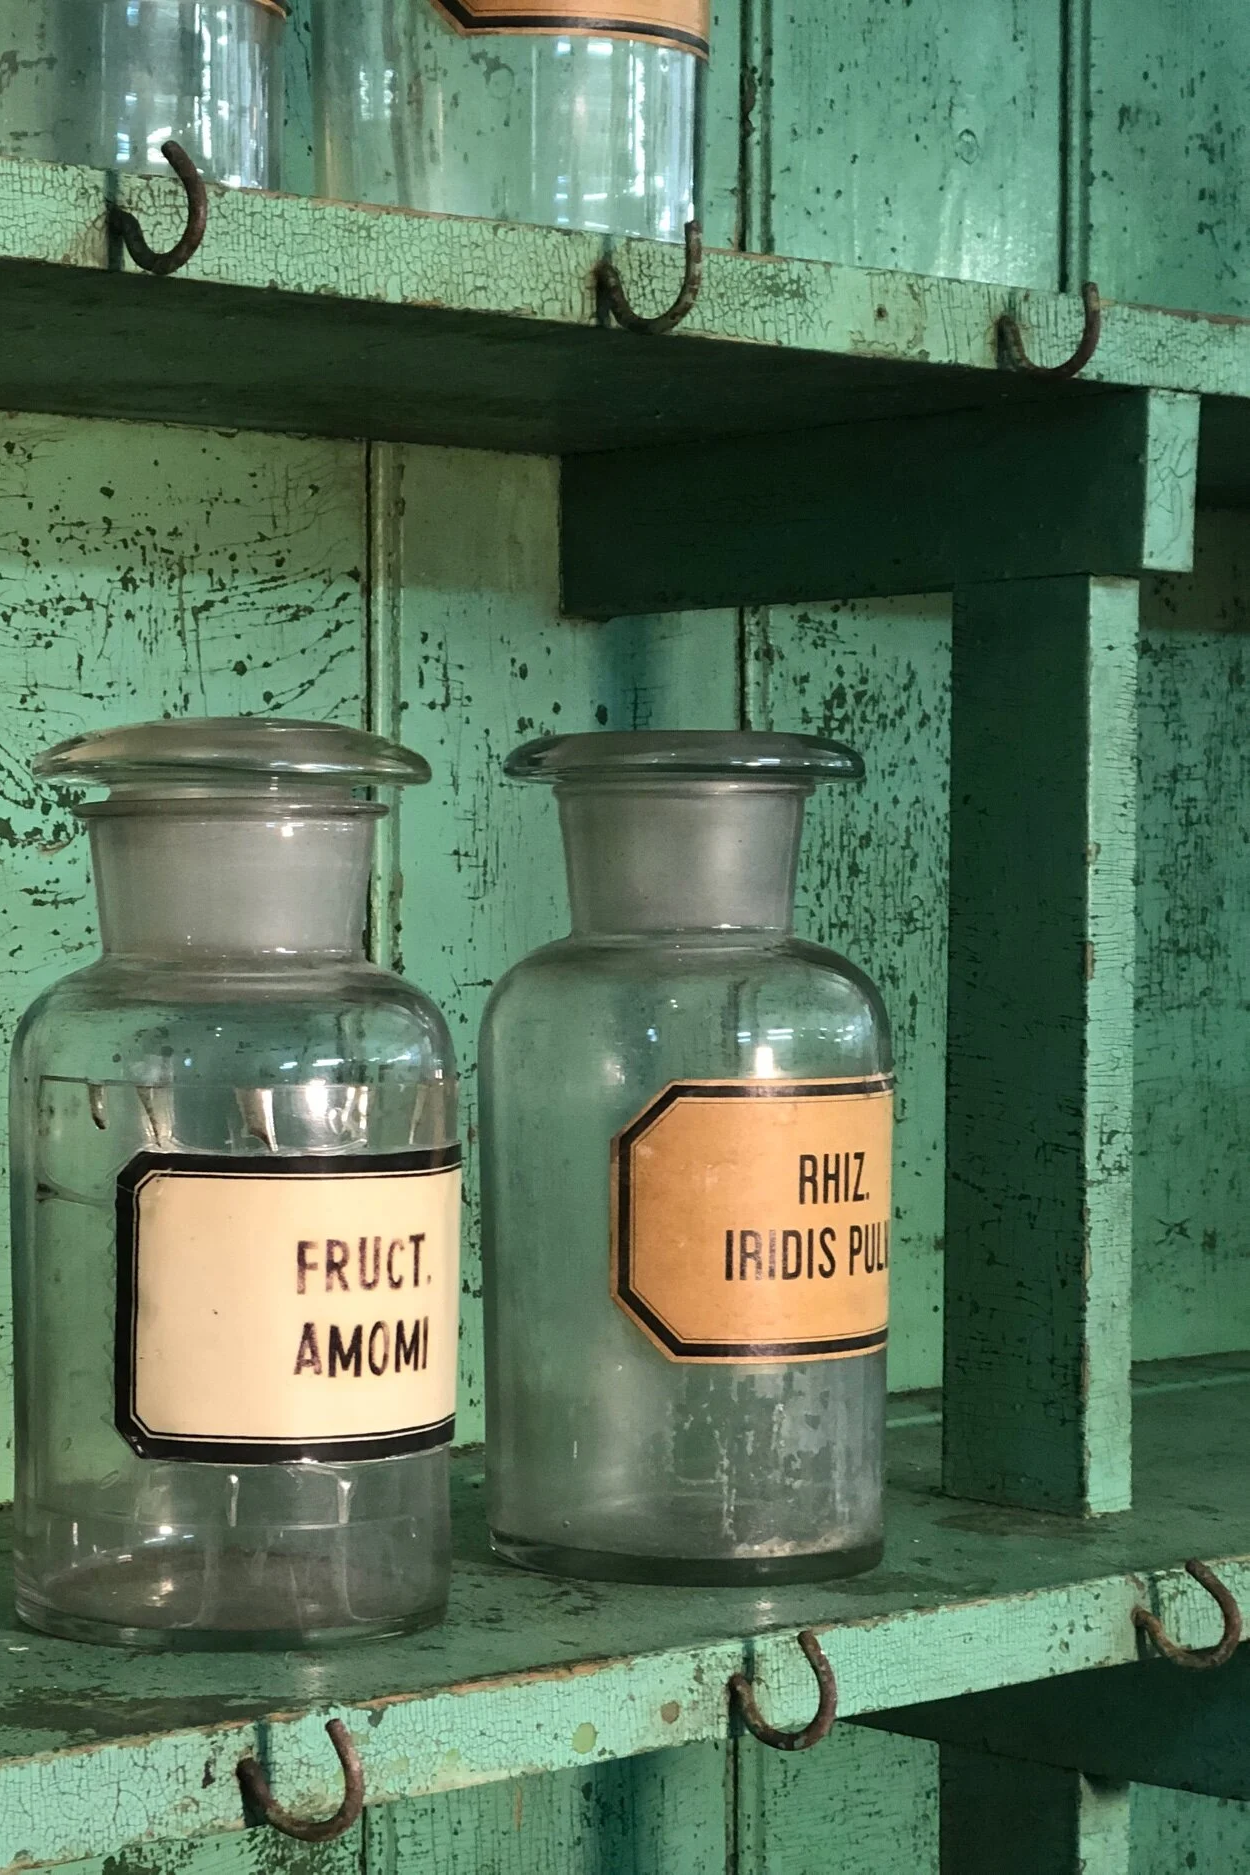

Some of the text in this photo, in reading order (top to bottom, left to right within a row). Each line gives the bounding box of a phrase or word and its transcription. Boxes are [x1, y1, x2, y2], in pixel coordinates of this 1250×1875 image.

[798, 1151, 870, 1205] RHIZ.
[296, 1232, 432, 1295] FRUCT.
[724, 1226, 837, 1281] IRIDIS
[293, 1316, 430, 1378] AMOMI
